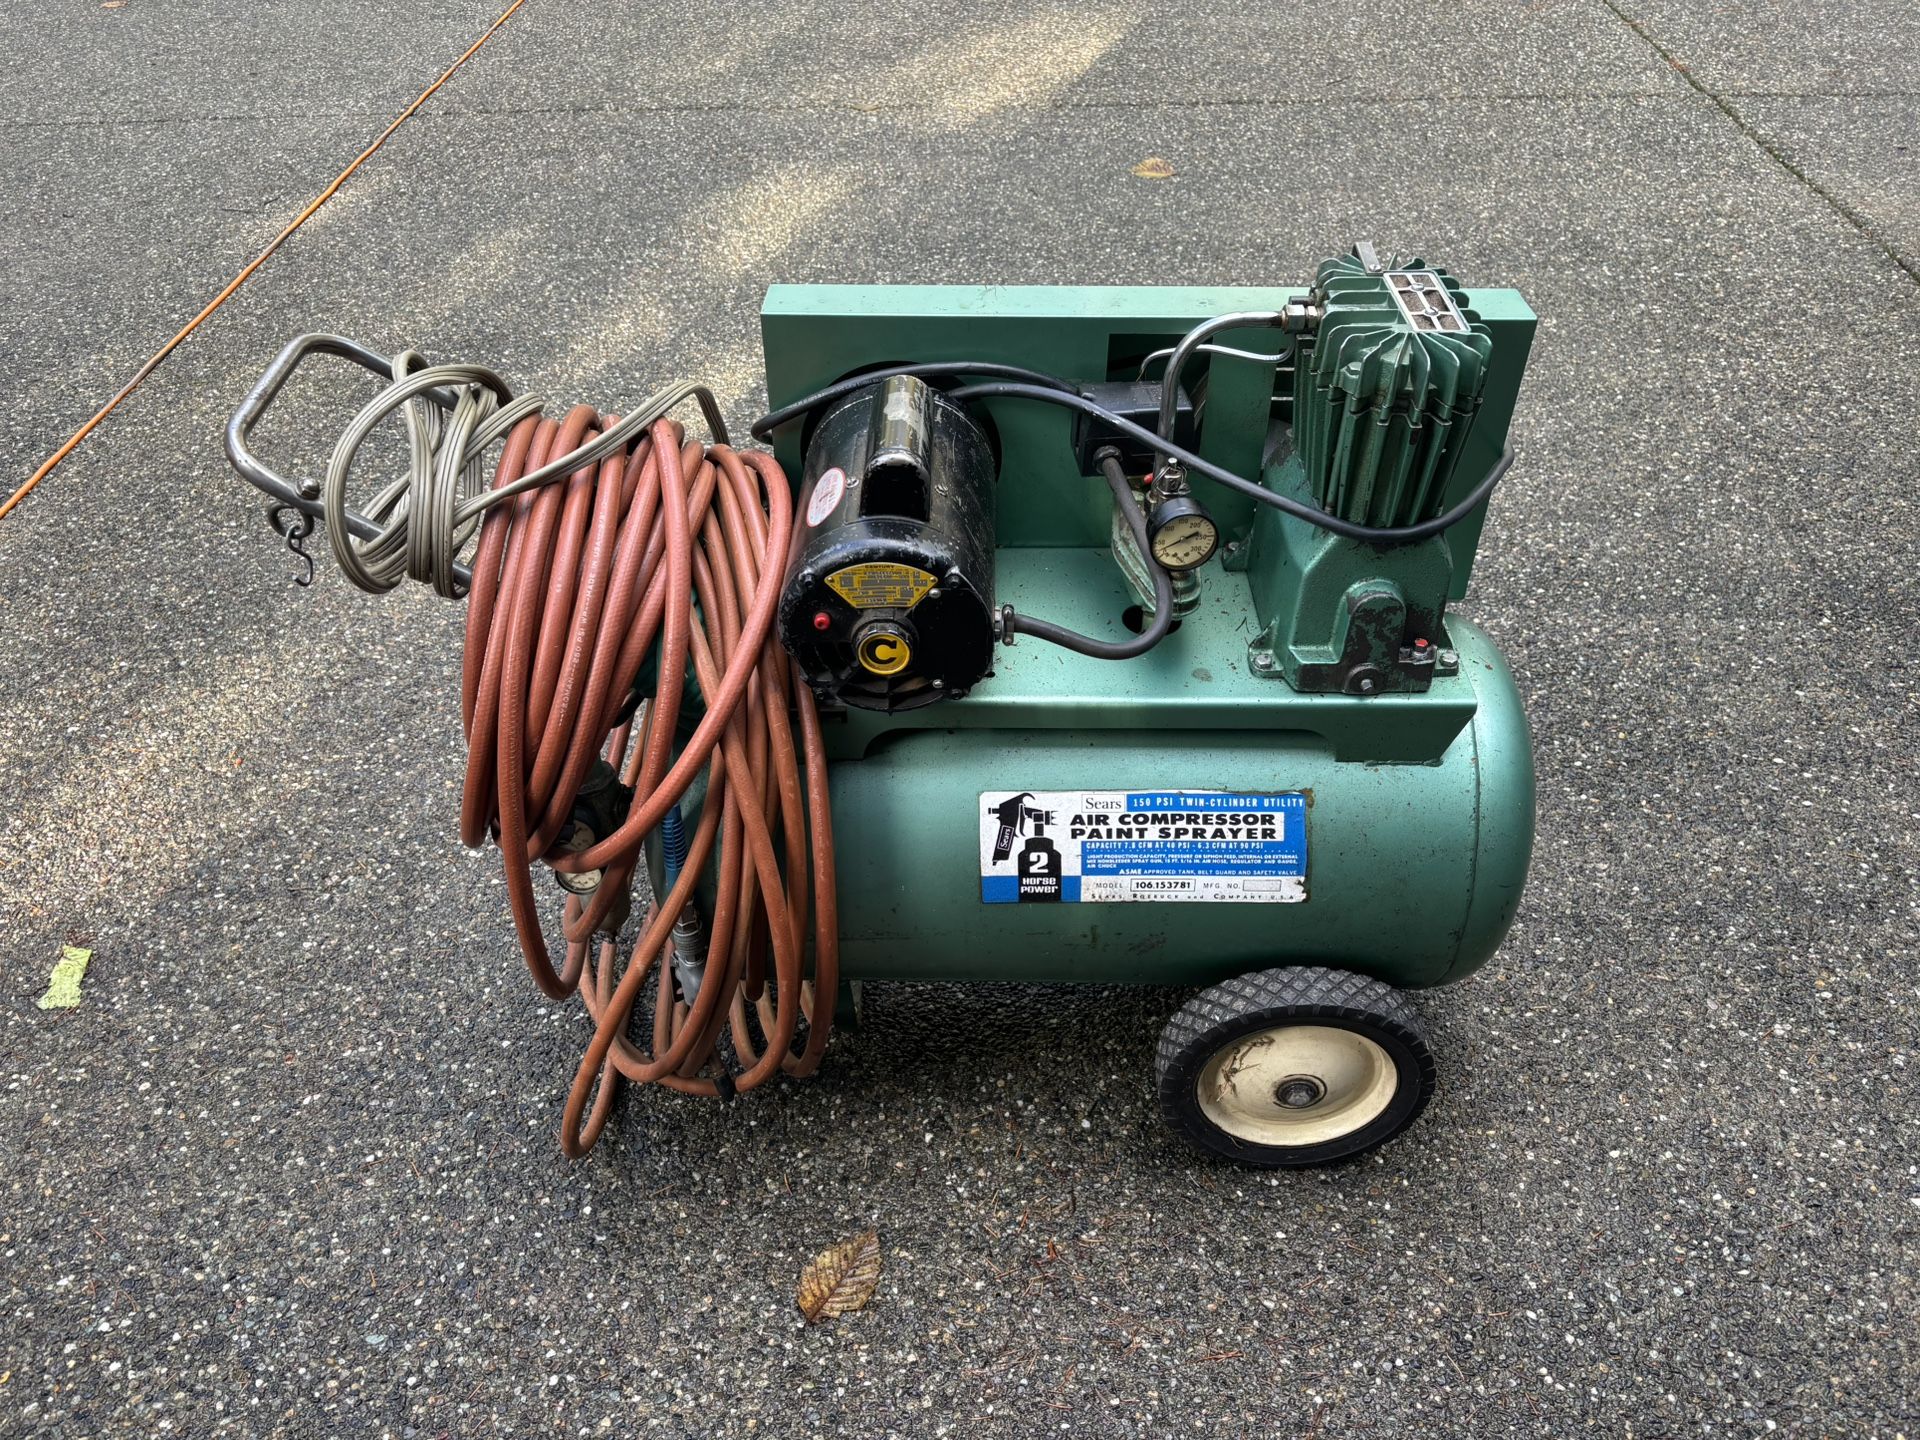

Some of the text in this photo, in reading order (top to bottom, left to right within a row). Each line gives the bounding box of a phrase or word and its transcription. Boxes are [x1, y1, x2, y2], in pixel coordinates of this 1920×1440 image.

[865, 638, 897, 665] C
[1085, 797, 1122, 810] Sears
[1133, 797, 1304, 807] 150 PSI TWIN-CYLINDER UTILITY
[1070, 813, 1275, 826] AIR COMPRESSOR
[1001, 828, 1011, 848] Sears
[1071, 828, 1277, 839] PAINT SPRAYER
[1029, 852, 1049, 873] 2
